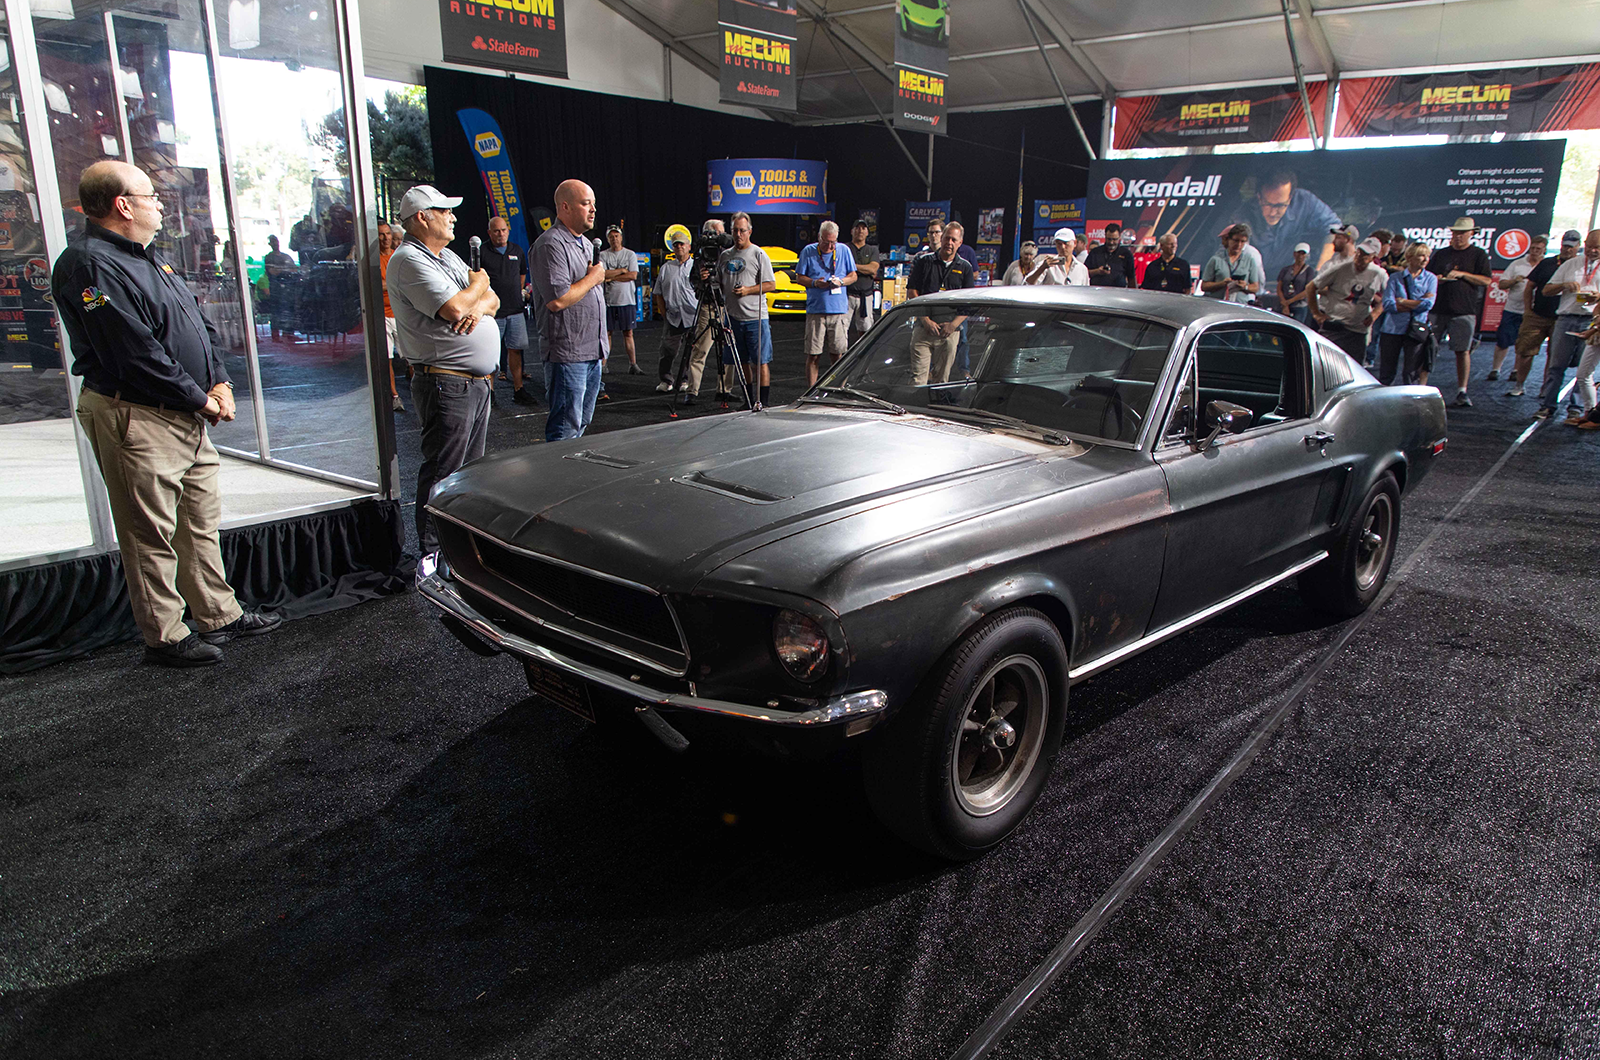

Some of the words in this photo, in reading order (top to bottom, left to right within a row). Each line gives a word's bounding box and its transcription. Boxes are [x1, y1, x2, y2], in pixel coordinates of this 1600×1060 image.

[450, 1, 556, 30] AUCTIONS
[725, 31, 790, 65] MECUM
[725, 55, 790, 75] AUCTIONS
[899, 70, 944, 97] MECUM
[899, 89, 944, 105] AUCTIONS
[1421, 84, 1512, 105] MECUM
[1180, 100, 1250, 120] MECUM
[1420, 102, 1510, 115] AUCTIONS
[1179, 116, 1249, 127] AUCTIONS
[478, 138, 498, 152] NAPA
[760, 170, 796, 182] TOOLS
[800, 170, 808, 182] &
[1482, 168, 1502, 176] might
[735, 177, 752, 187] NAPA
[1126, 175, 1222, 198] Kendall
[499, 170, 517, 204] TOOLS
[509, 207, 519, 216] &
[758, 185, 817, 198] EQUIPMENT
[1122, 199, 1178, 207] MOTOR
[1187, 198, 1216, 206] OIL
[909, 208, 941, 216] CARLYLE
[1511, 207, 1537, 215] engine.
[1402, 228, 1432, 239] YOU
[1432, 228, 1453, 239] GE
